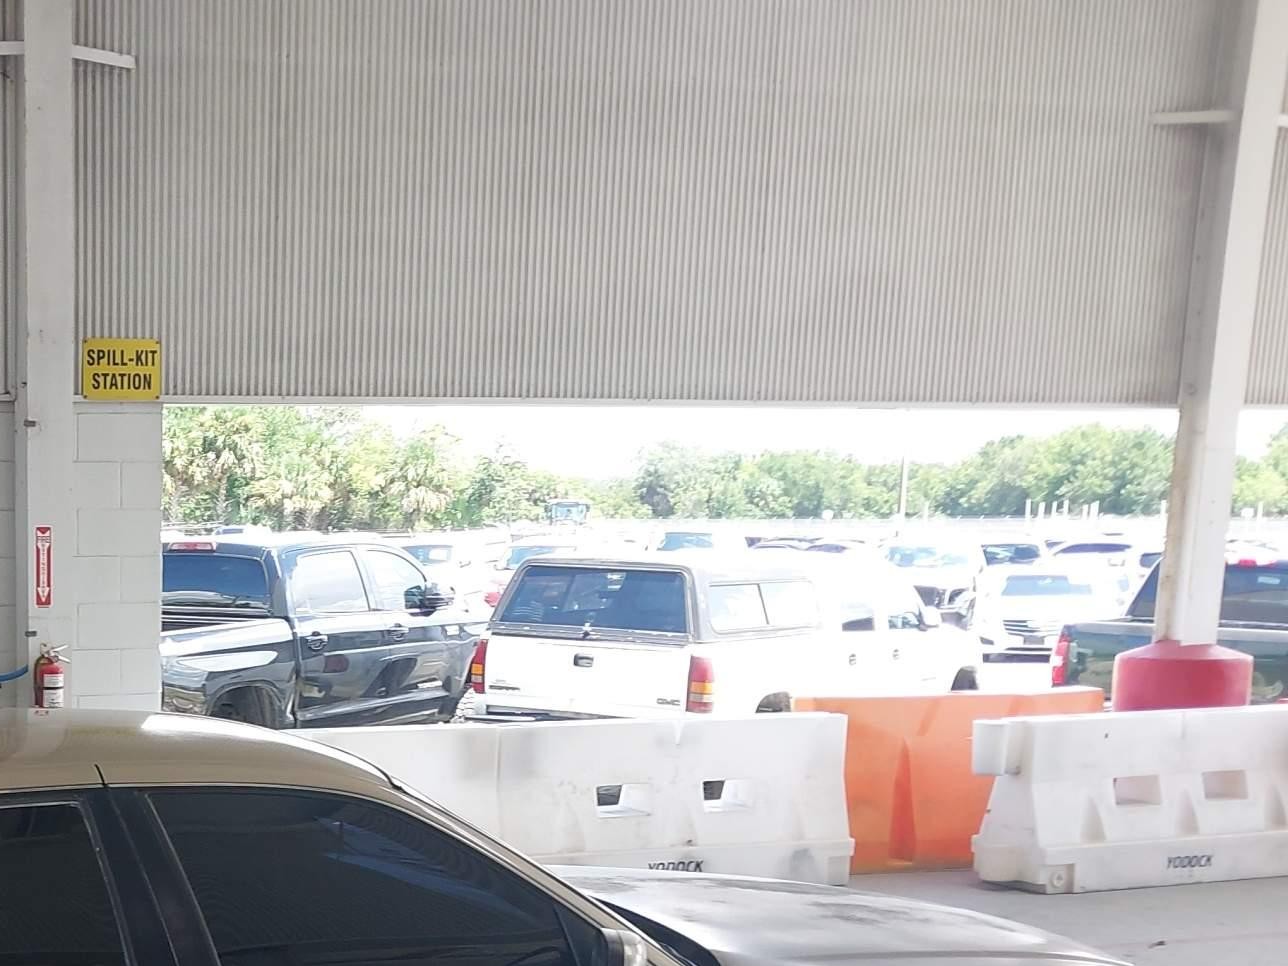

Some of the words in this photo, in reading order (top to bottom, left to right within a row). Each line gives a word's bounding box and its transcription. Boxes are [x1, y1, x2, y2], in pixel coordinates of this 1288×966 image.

[86, 348, 158, 367] SPILL-KIT
[91, 372, 152, 390] STATION
[1167, 855, 1213, 869] YODOCK
